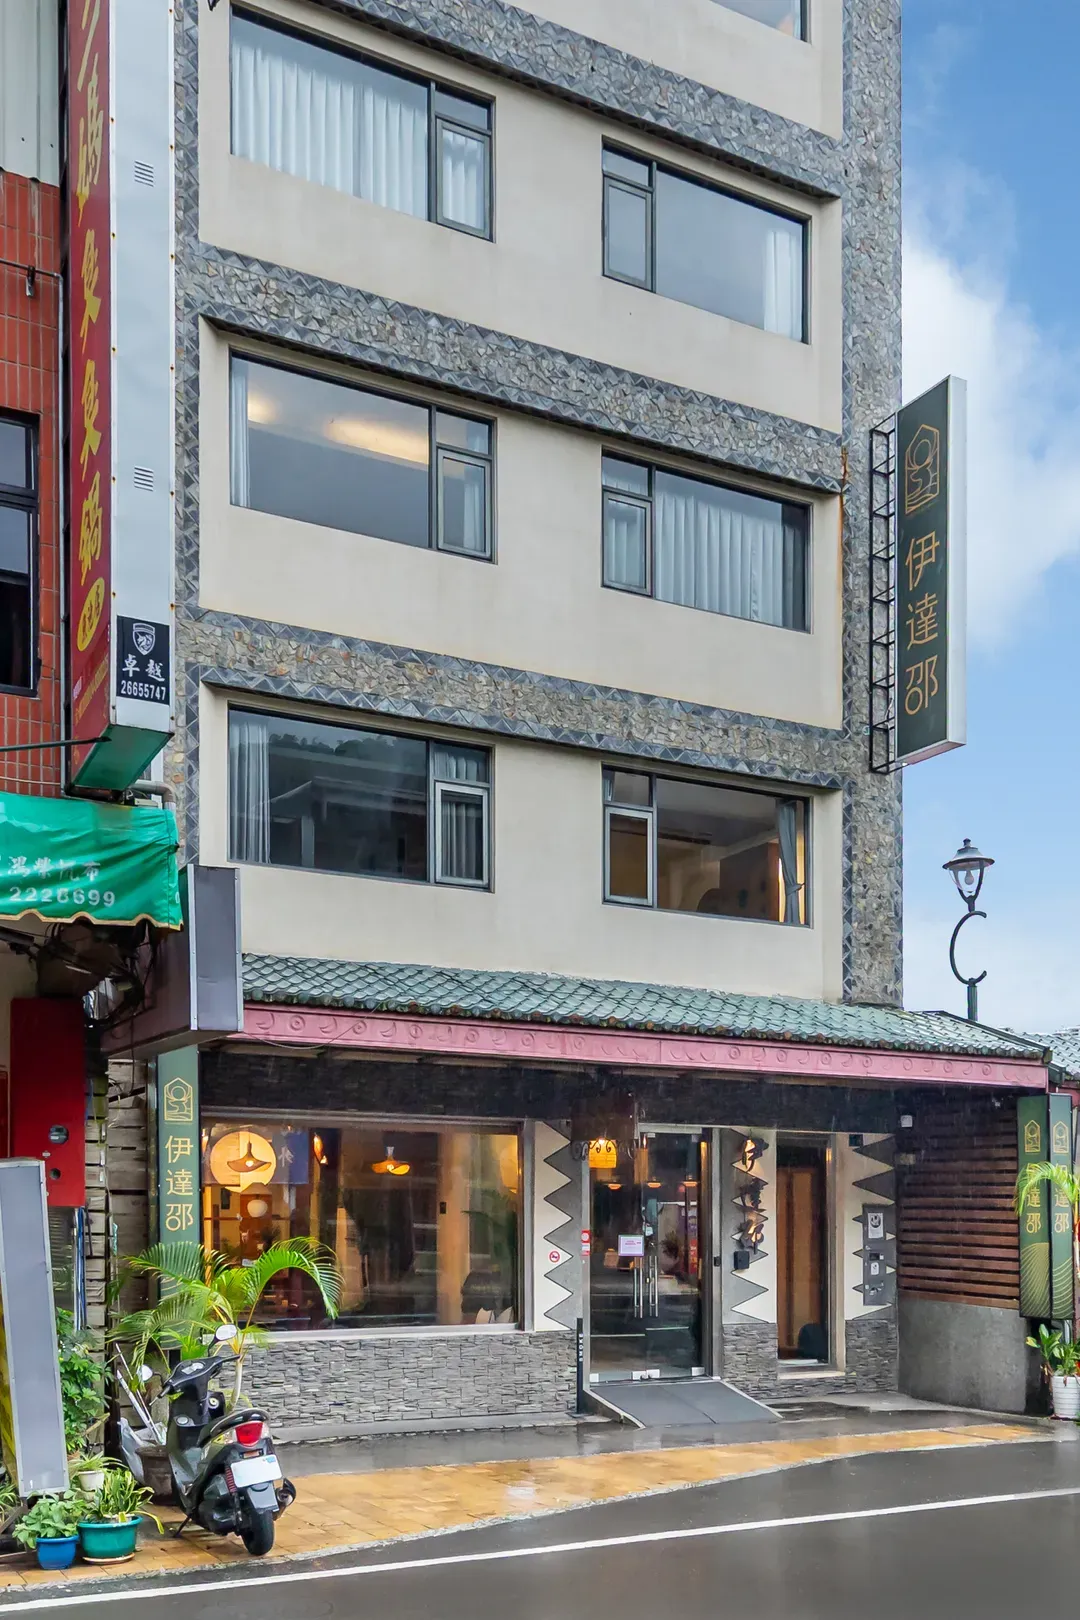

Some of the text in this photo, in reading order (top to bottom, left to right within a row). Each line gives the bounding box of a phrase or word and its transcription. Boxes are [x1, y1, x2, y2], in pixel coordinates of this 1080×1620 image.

[905, 531, 940, 715] 伊達邵
[120, 679, 166, 700] 26655747
[122, 653, 165, 682] 卓越
[165, 1135, 194, 1231] 伊達邵
[1025, 1164, 1042, 1233] 達邵
